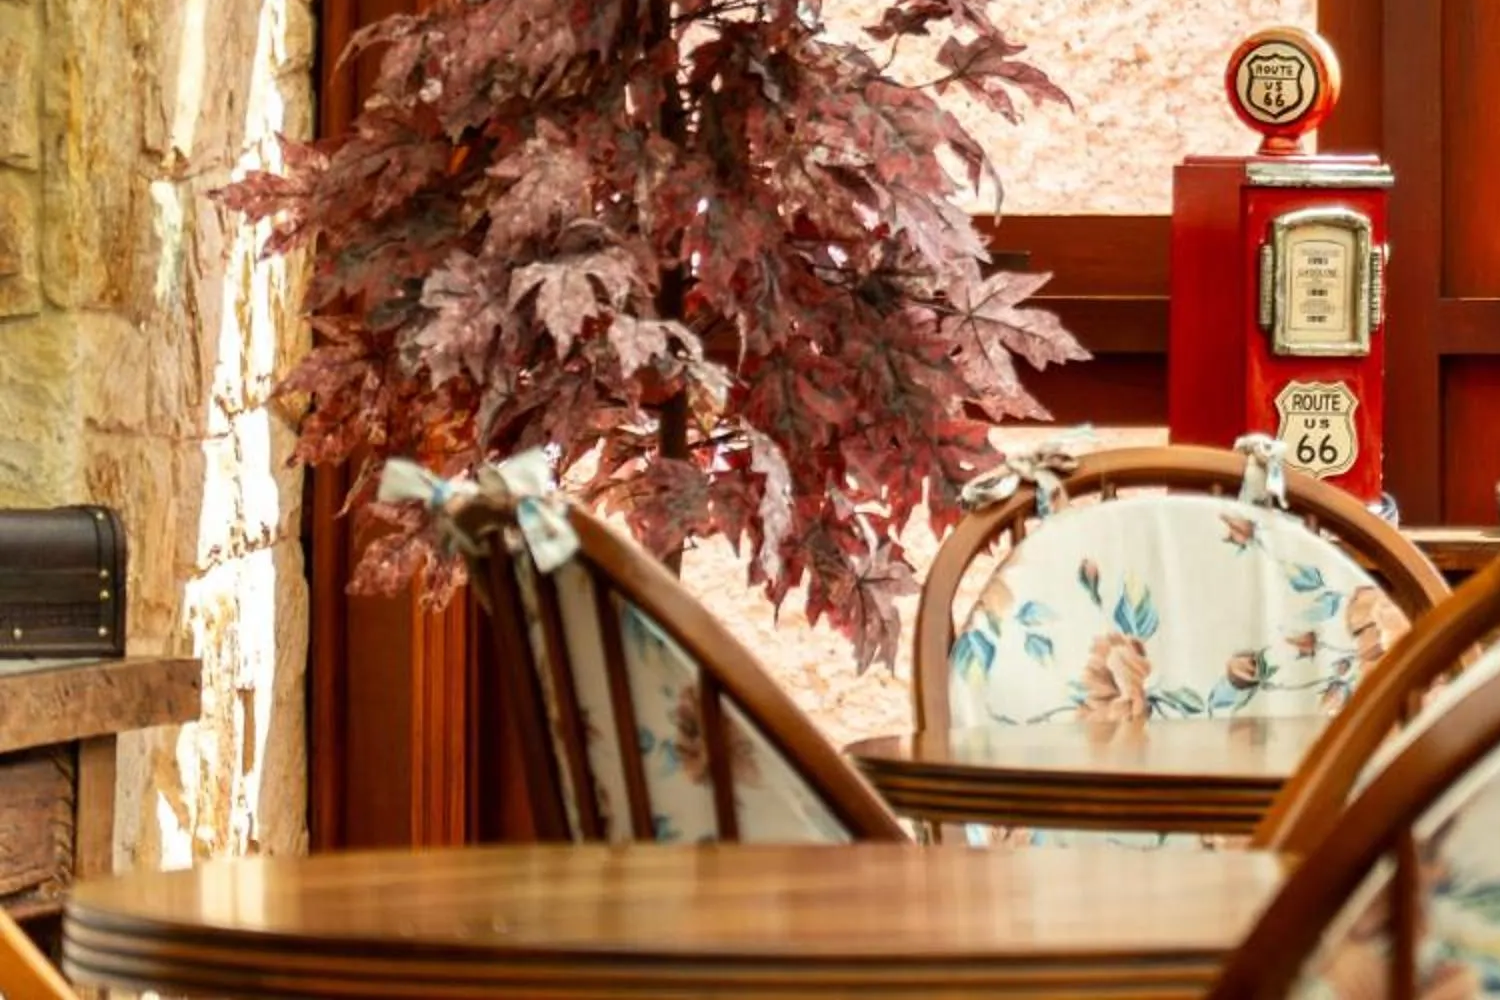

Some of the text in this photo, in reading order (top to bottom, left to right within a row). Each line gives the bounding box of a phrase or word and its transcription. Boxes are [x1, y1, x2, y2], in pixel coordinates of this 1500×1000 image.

[1255, 64, 1293, 77] ROUTE
[1263, 91, 1285, 107] 66
[1291, 393, 1341, 411] ROUTE
[1304, 418, 1330, 430] US
[1296, 433, 1339, 465] 66
